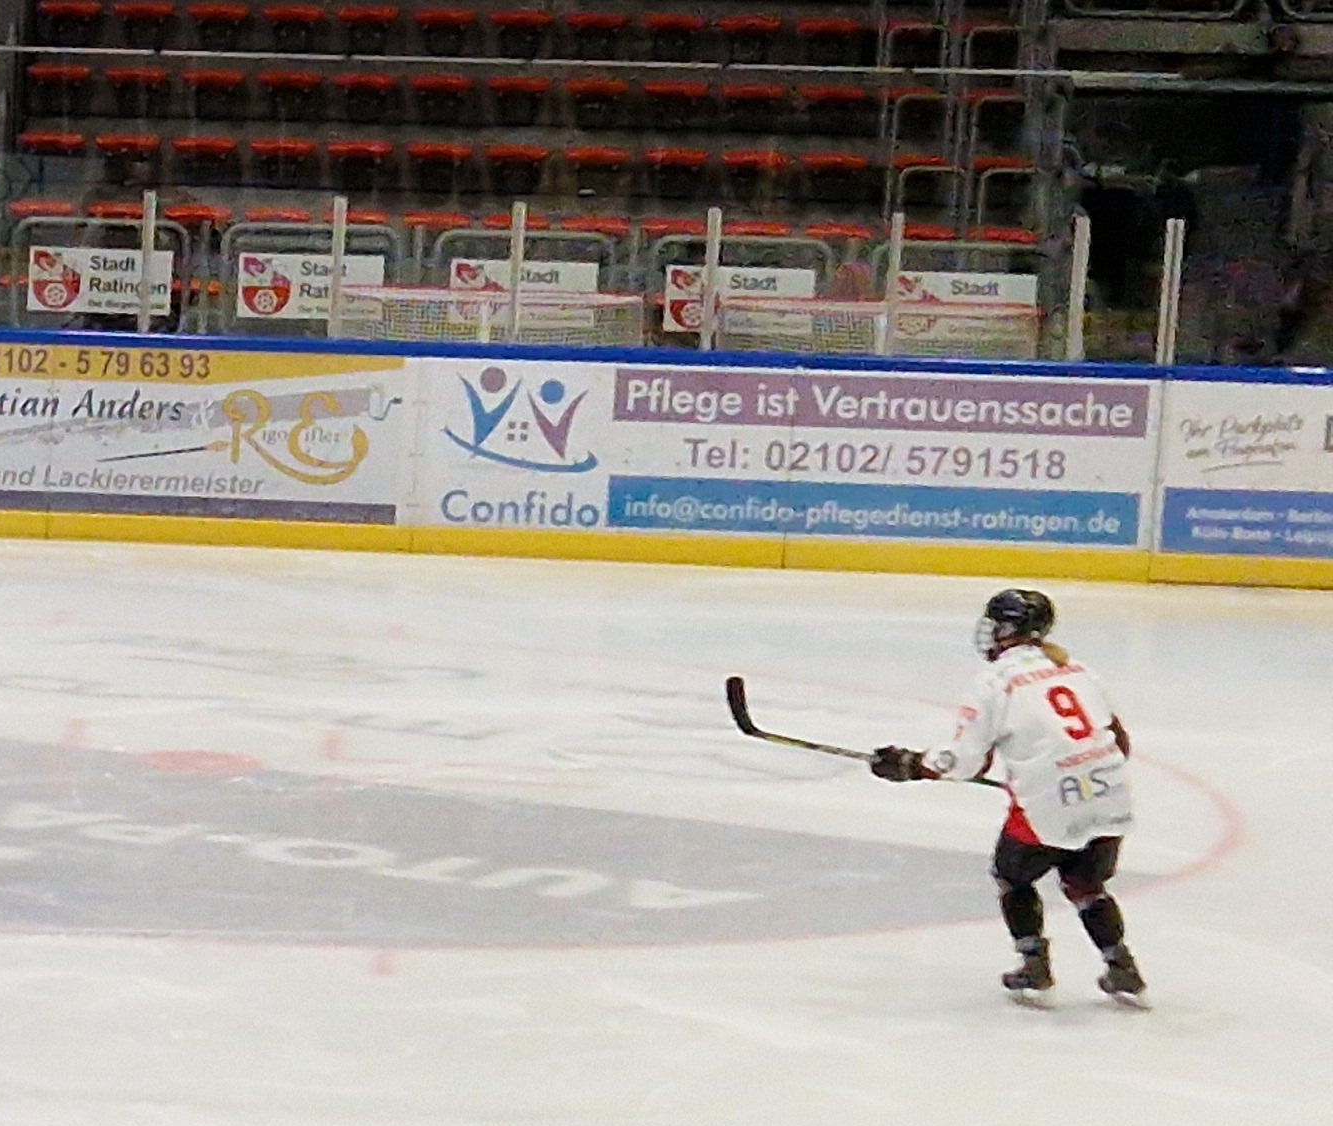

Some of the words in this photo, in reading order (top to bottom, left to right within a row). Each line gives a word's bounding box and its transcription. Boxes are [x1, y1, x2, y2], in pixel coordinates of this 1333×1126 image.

[89, 255, 136, 272] Stadt
[730, 274, 778, 291] Stadt
[950, 279, 1000, 296] Stadt
[77, 349, 90, 376] 5
[101, 350, 131, 377] 79
[140, 351, 170, 378] 63
[178, 353, 211, 380] 93
[71, 388, 186, 423] Anders
[626, 377, 743, 423] Pflege
[756, 381, 798, 416] ist
[812, 384, 1134, 428] Vertrauenssache
[684, 437, 750, 470] Tel:
[764, 441, 893, 476] 02102/
[906, 446, 1068, 481] 5791518
[42, 466, 264, 497] Lackierermeister
[440, 488, 601, 528] Confido
[622, 494, 1121, 537] info@confido-pflegedienst-ratingen.de
[1047, 684, 1094, 741] 9
